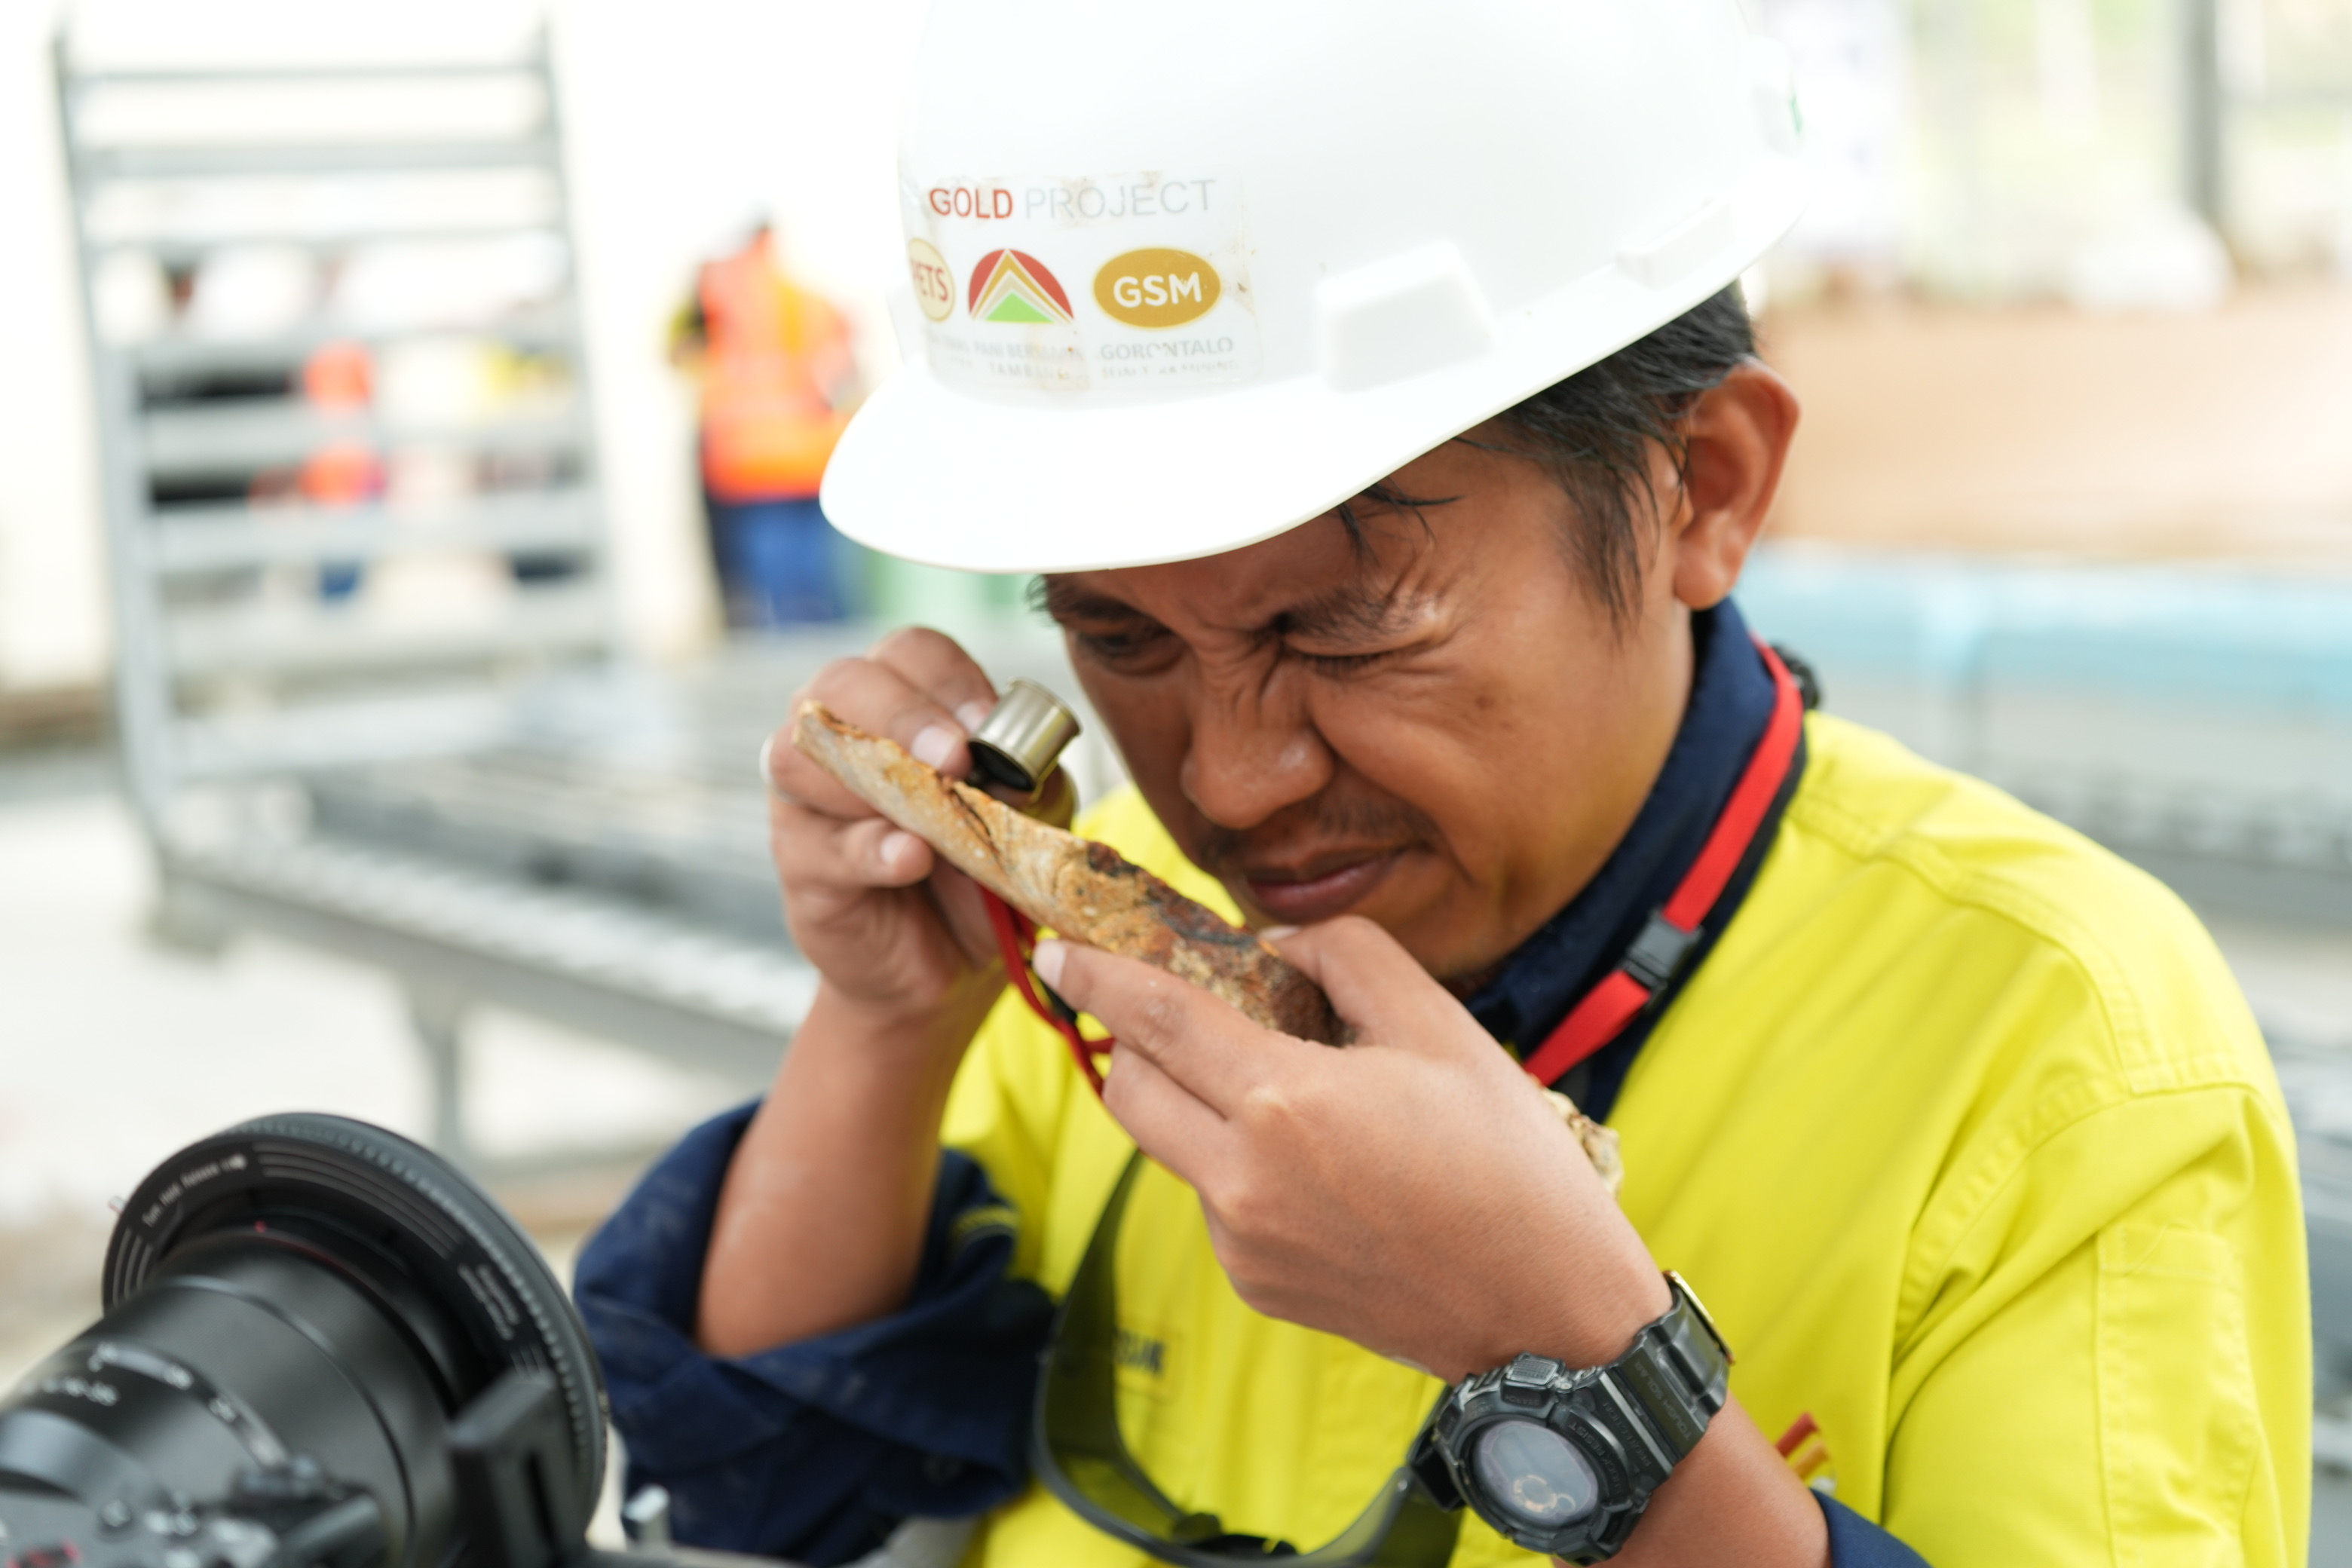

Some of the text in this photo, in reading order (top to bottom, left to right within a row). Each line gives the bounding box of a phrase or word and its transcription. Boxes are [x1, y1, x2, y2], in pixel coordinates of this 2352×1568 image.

[929, 179, 1217, 219] GOLD PROJECT
[1113, 271, 1202, 308] GSM
[1100, 335, 1234, 361] GORONTALO
[1662, 1398, 1691, 1441] TOUGH
[1568, 1421, 1606, 1457] RESIST
